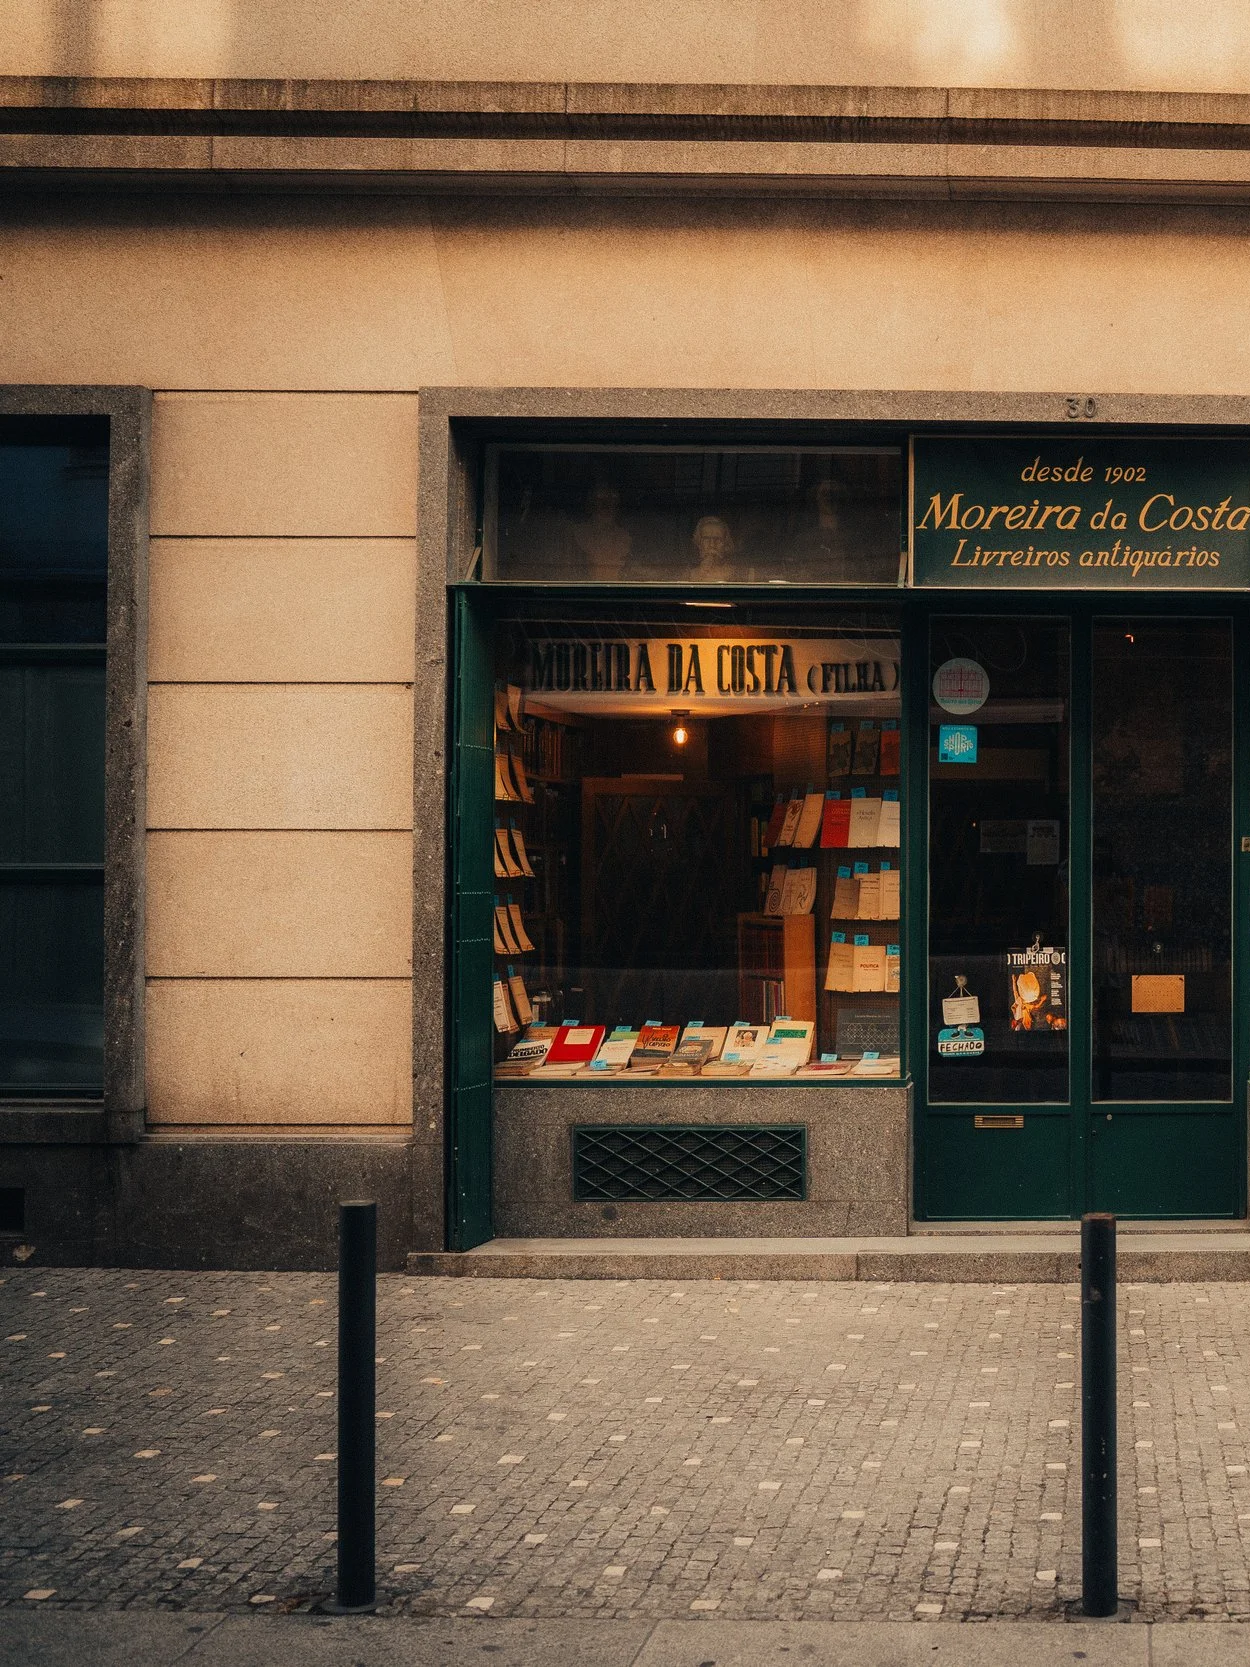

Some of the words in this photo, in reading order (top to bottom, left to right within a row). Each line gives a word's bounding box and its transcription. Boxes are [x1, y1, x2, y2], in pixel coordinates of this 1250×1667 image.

[1066, 398, 1097, 419] 30
[1021, 456, 1094, 482] desde
[1104, 466, 1147, 485] 1902
[915, 492, 1081, 531] Moreira
[1089, 499, 1127, 531] da
[951, 539, 1071, 567] Livreiros
[1079, 538, 1220, 577] antiquários
[531, 641, 657, 693] MOREIRA
[667, 643, 706, 695] DA
[716, 644, 798, 695] COSTA
[1012, 953, 1050, 965] TRIPEIRO
[509, 1048, 548, 1057] DELGADO
[940, 1041, 983, 1052] FECHADO
